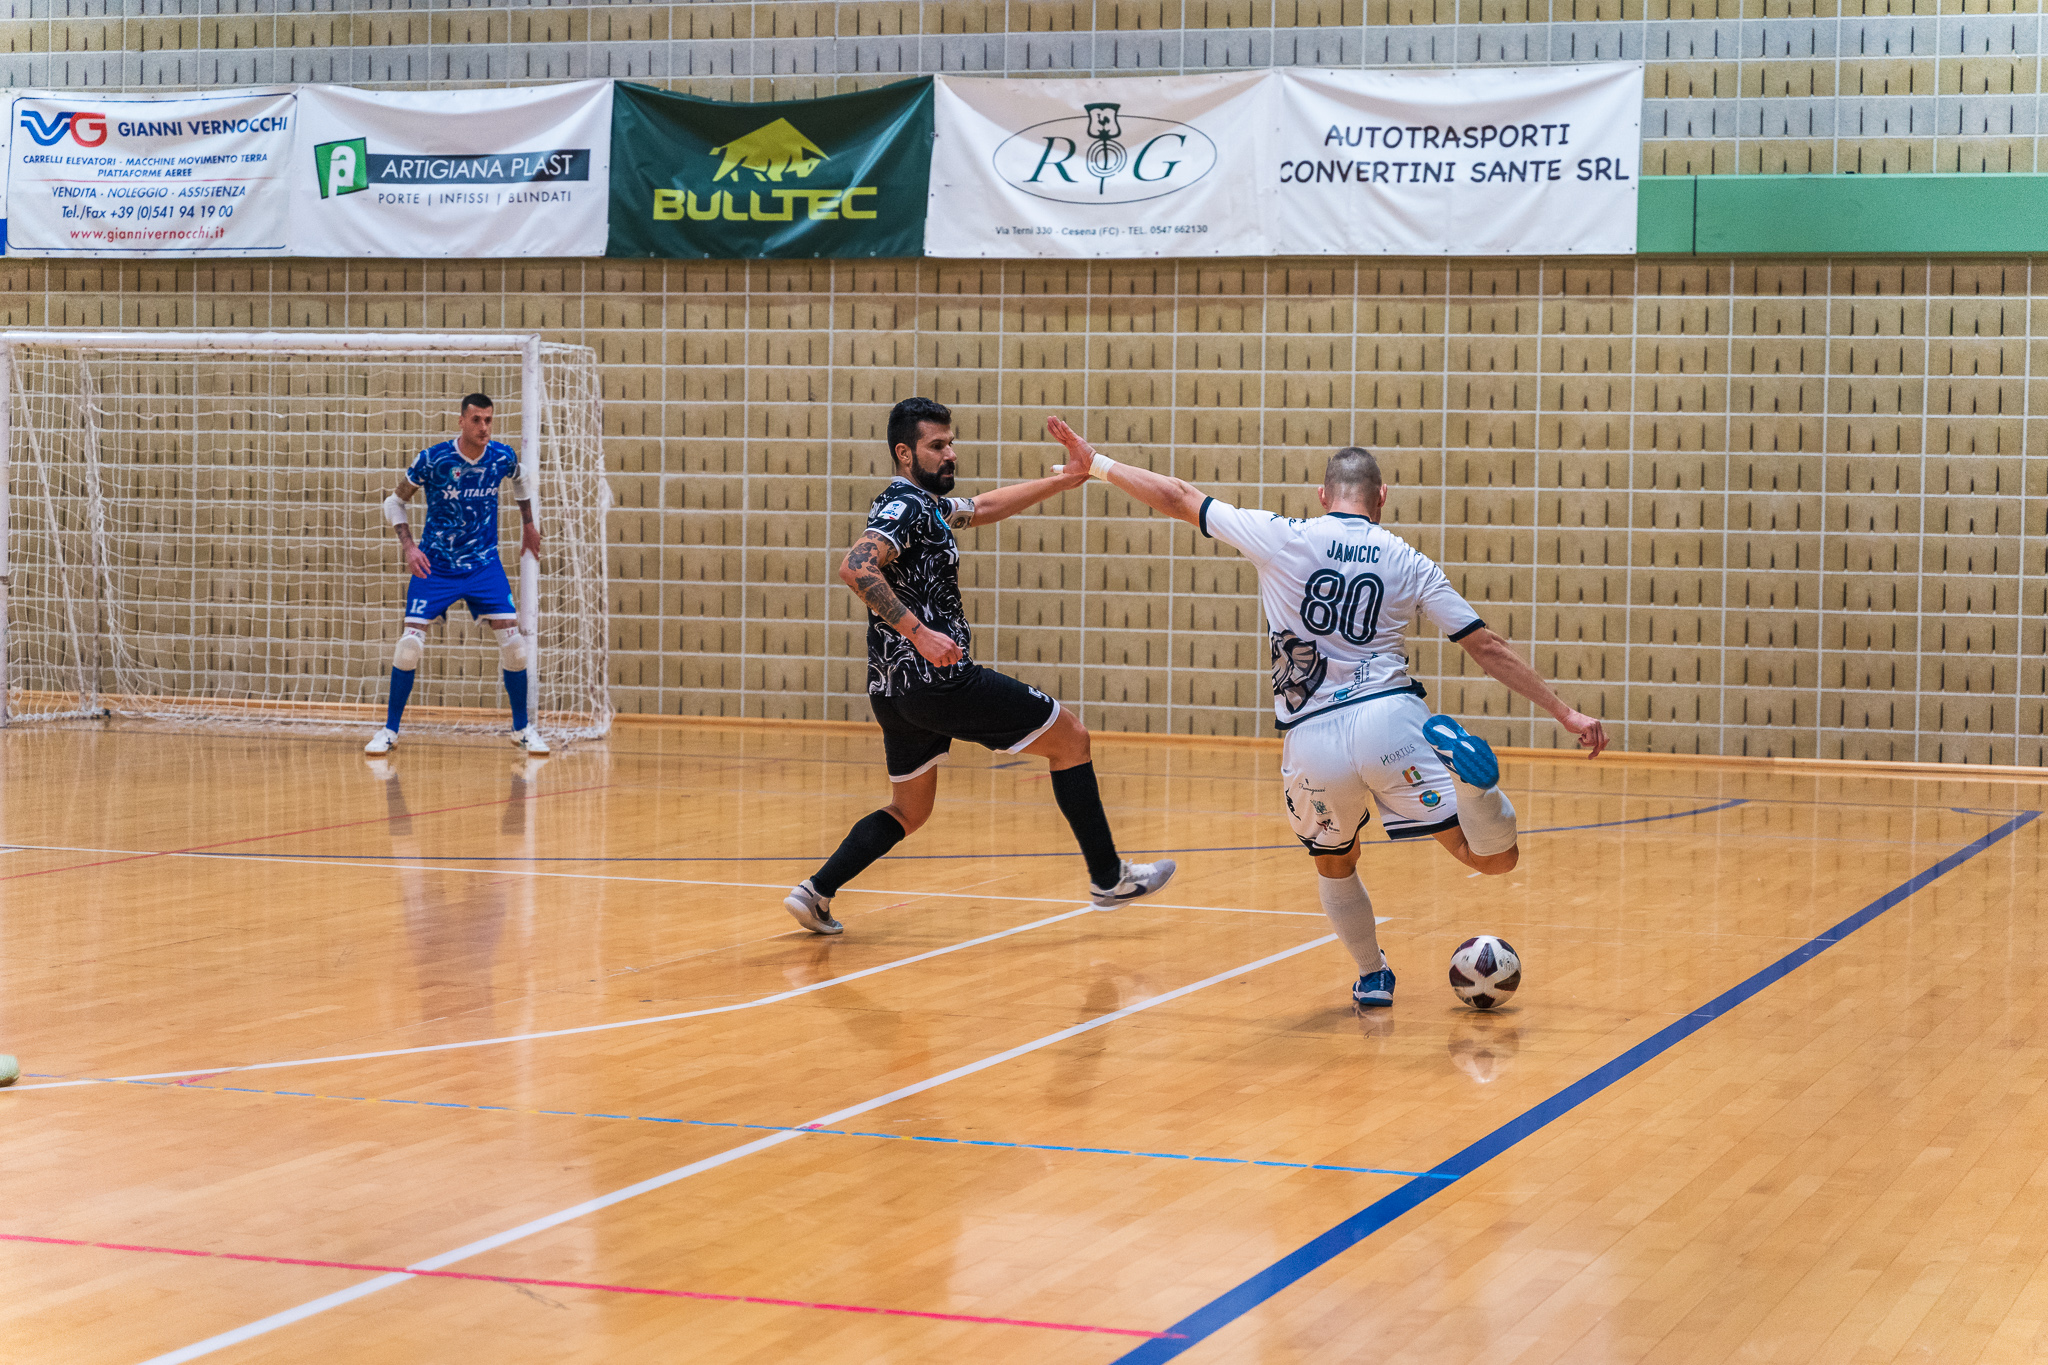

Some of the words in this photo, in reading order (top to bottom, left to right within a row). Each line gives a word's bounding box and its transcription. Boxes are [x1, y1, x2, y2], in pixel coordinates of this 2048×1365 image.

[118, 121, 182, 137] GIANNI
[188, 116, 288, 136] VERNOCCHI
[1325, 124, 1570, 148] AUTOTRASPORTI
[22, 154, 63, 165] CARRELLI
[66, 156, 116, 166] ELEVATORI
[125, 157, 175, 166] MACCHINE
[178, 154, 238, 165] MOVIMENTO
[240, 152, 268, 163] TERRA
[381, 158, 504, 179] ARTIGIANA
[510, 154, 574, 178] PLAST
[97, 168, 162, 178] PIATTAFORME
[164, 168, 192, 177] AEREE
[1280, 160, 1456, 184] CONVERTINI
[1470, 159, 1562, 184] SANTE
[1576, 157, 1630, 181] SRL
[52, 186, 97, 198] VENDITA
[107, 186, 168, 199] NOLEGGIO
[178, 186, 246, 198] ASSISTENZA
[378, 193, 420, 204] PORTE
[439, 192, 489, 204] INFISSI
[508, 190, 572, 203] BLINDATI
[653, 187, 878, 221] BULLTEC
[62, 205, 107, 220] Tel./Fax
[110, 206, 134, 219] +39
[136, 205, 173, 220] (0)541
[178, 206, 196, 218] 94
[200, 205, 216, 218] 19
[218, 205, 233, 218] 00
[70, 227, 225, 243] www.giannivernocchi.it
[995, 226, 1010, 235] Via
[1012, 226, 1034, 235] Terni
[1036, 226, 1053, 235] 330
[1061, 227, 1096, 236] Cesena
[1099, 226, 1119, 236] (FC)
[1150, 225, 1171, 234] 0547
[1175, 225, 1208, 234] 662130
[411, 598, 427, 614] 12
[1300, 569, 1384, 645] 80
[1380, 744, 1415, 766] HORTUS
